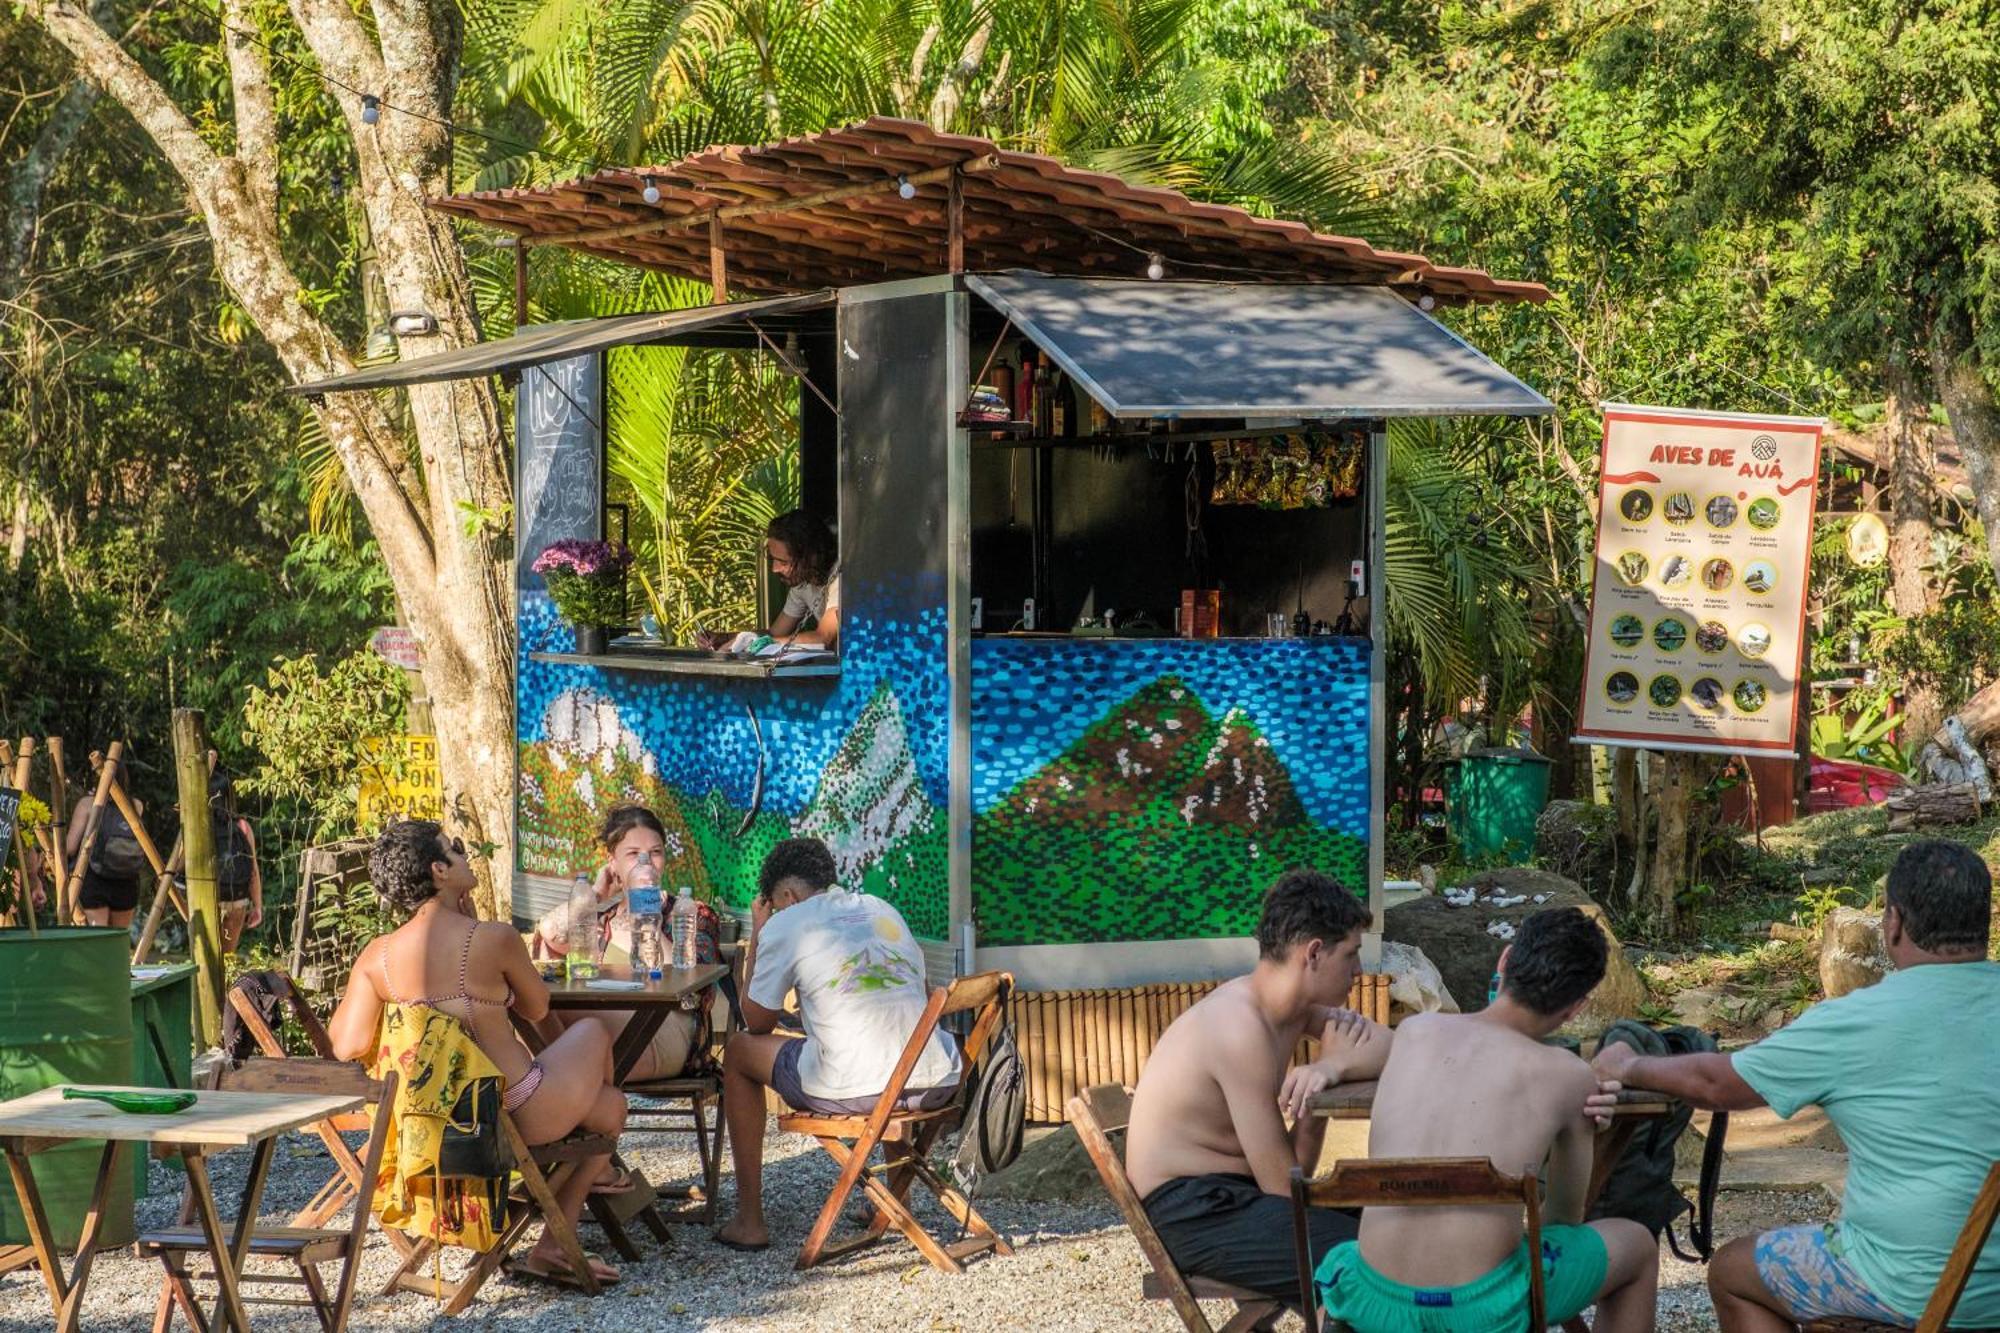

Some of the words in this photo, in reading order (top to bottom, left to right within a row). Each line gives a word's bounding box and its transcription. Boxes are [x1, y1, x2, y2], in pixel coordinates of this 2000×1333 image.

[1650, 444, 1703, 465] AVES
[1708, 448, 1735, 467] DE
[1738, 459, 1783, 479] AUÁ
